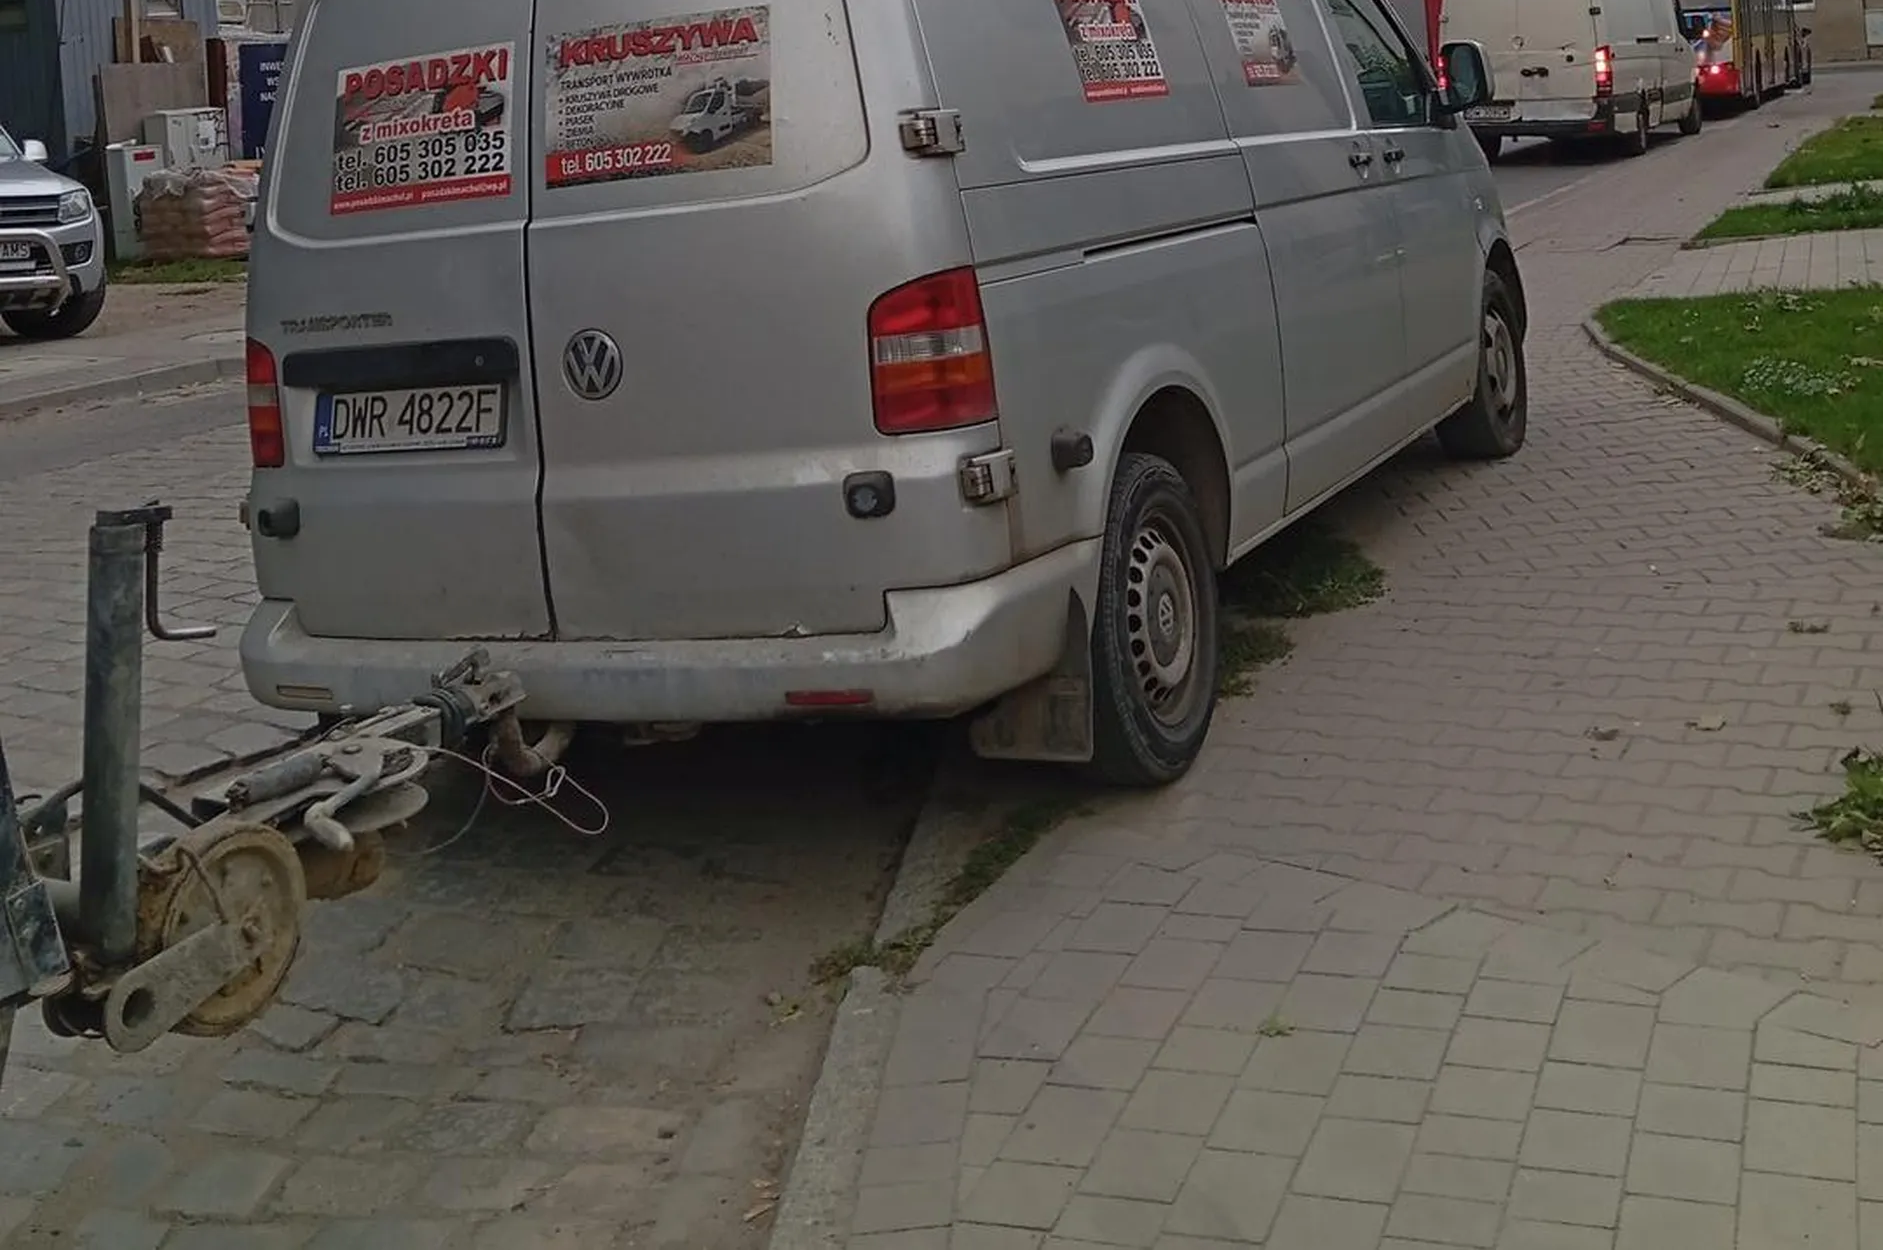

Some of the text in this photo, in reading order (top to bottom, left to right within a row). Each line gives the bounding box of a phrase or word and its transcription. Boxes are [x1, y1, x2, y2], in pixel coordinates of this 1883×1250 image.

[559, 16, 759, 68] KRUSZYWA
[345, 47, 508, 100] POSADZKI
[561, 74, 614, 90] TRANSPORT
[337, 130, 505, 171] tel. 605 305 035
[361, 128, 372, 142] z
[336, 152, 505, 192] tel. 605 302 222
[585, 150, 613, 172] 605
[615, 147, 642, 169] 302
[644, 143, 672, 164] 222
[332, 388, 498, 440] DWR 4822F
